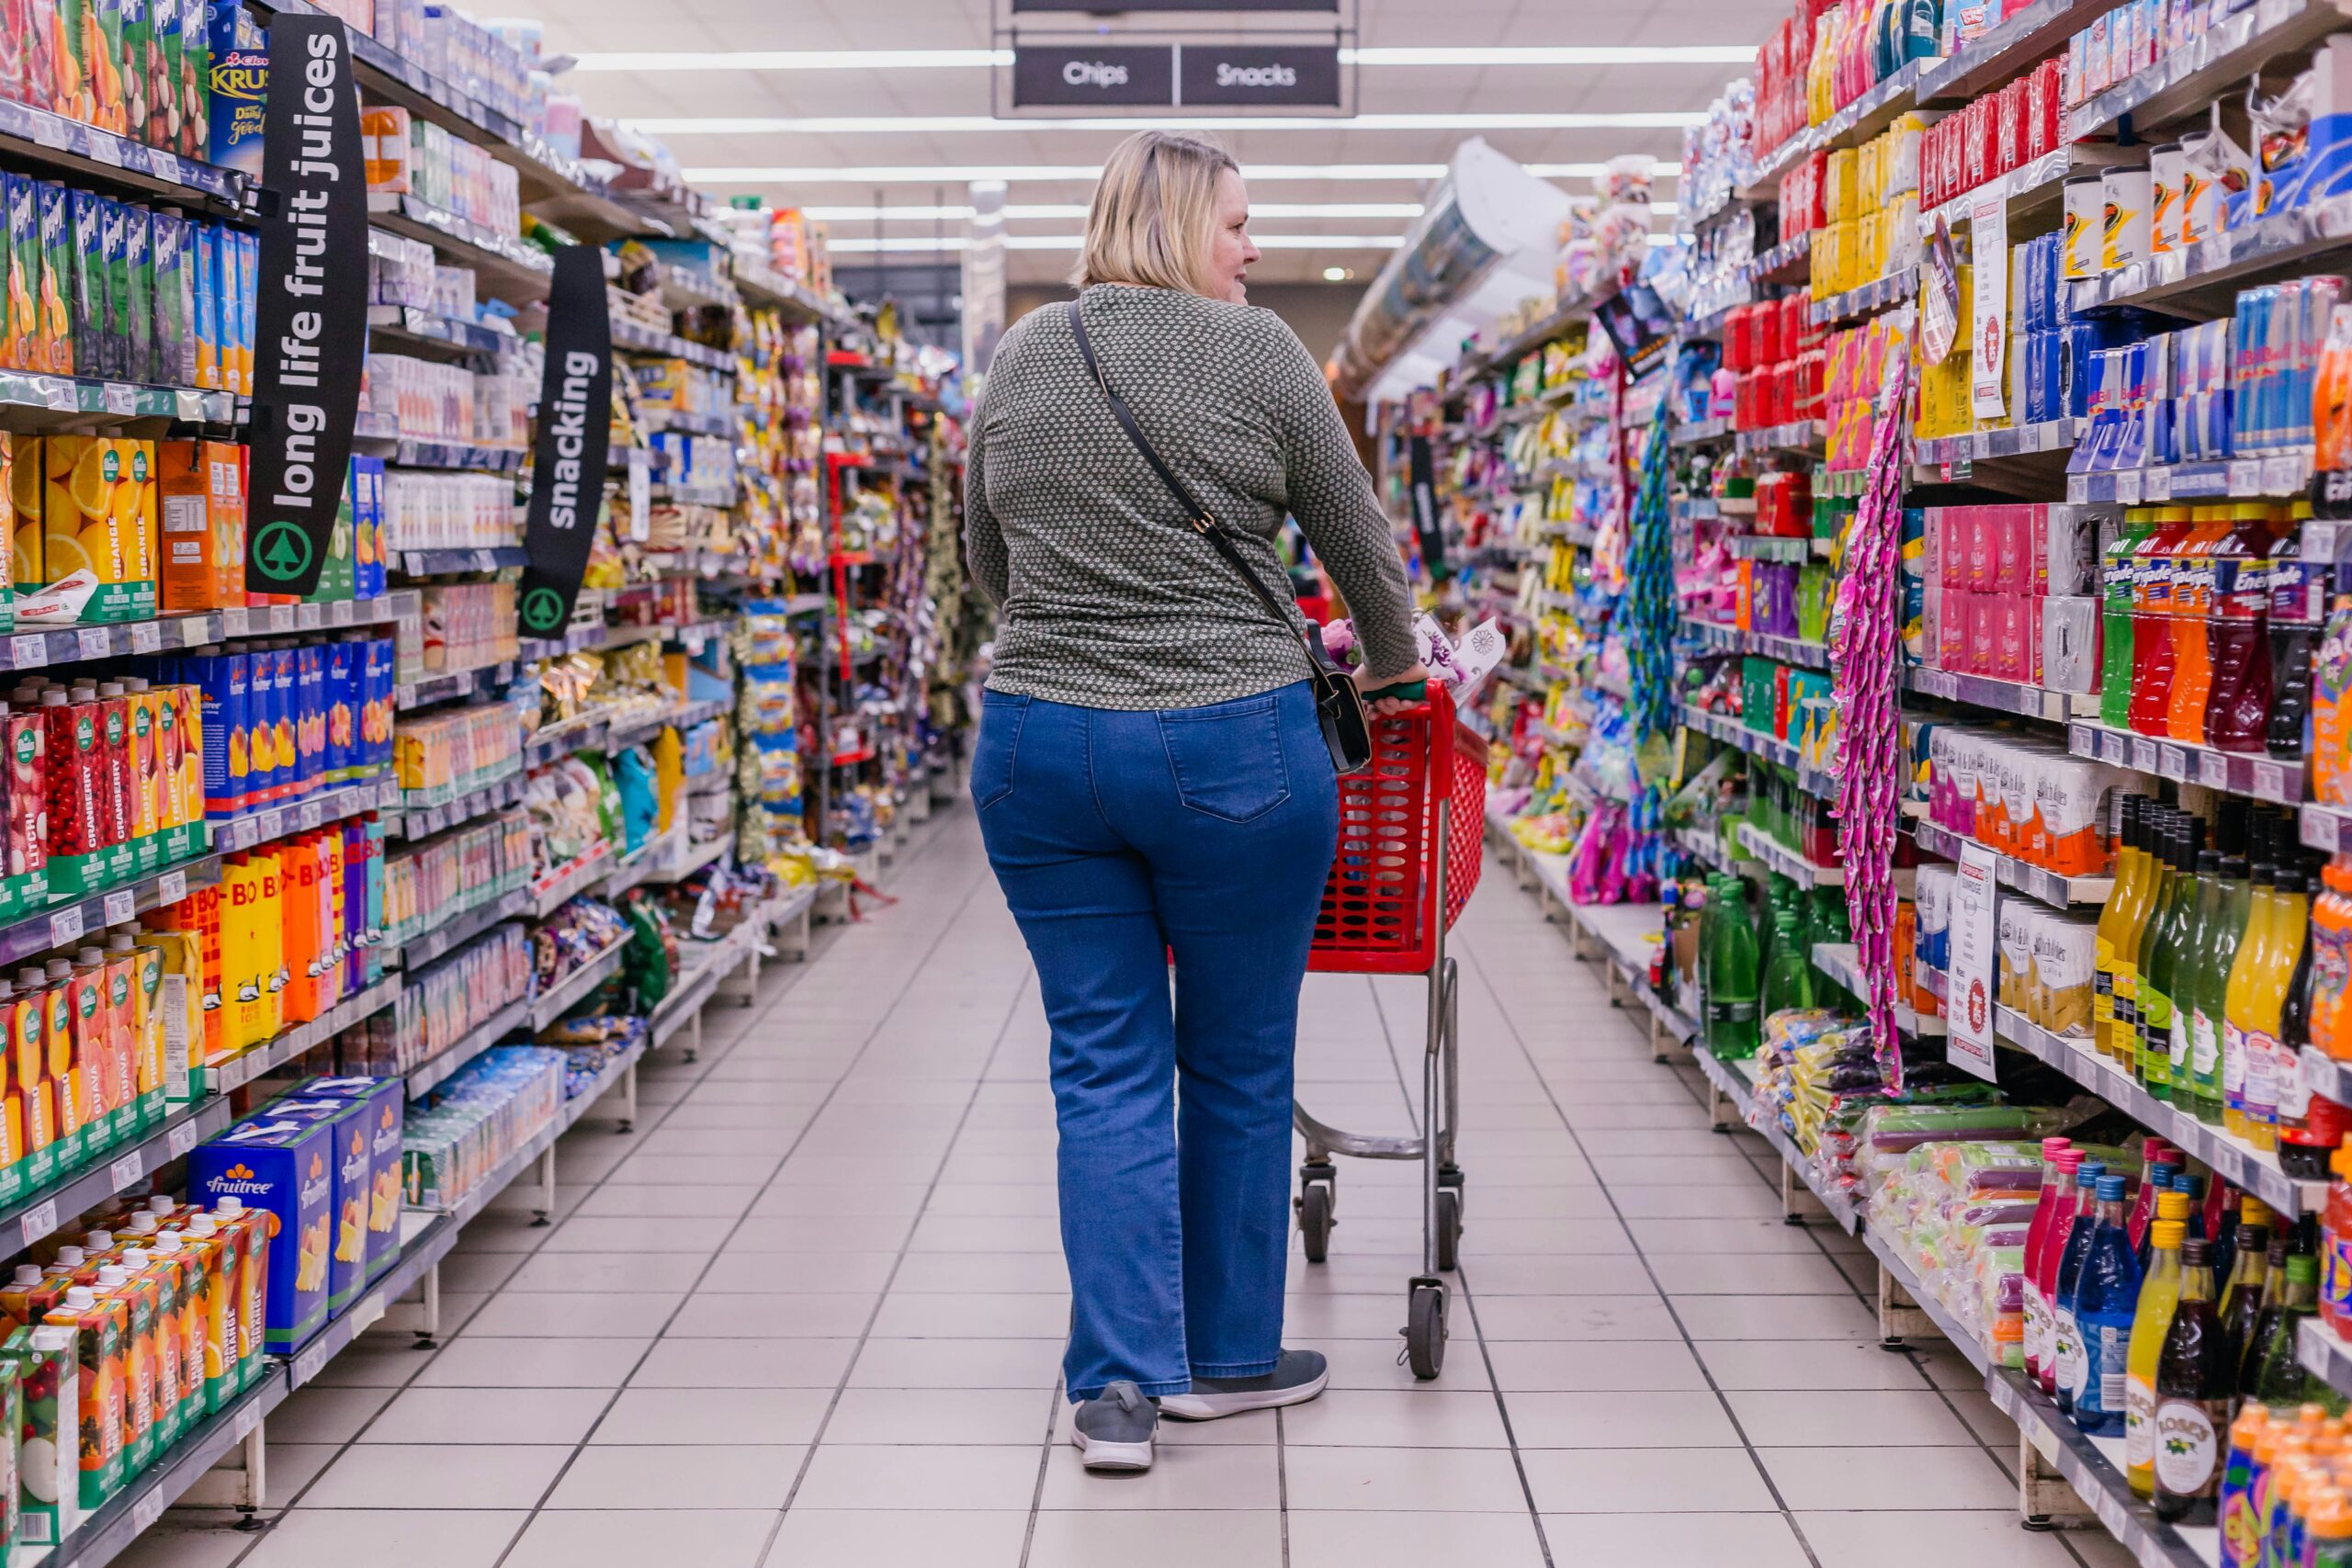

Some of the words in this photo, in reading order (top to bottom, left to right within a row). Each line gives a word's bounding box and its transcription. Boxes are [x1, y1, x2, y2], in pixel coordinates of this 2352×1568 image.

[210, 69, 268, 89] KRU
[242, 55, 269, 66] Clov
[1063, 61, 1128, 88] Chips
[1216, 62, 1296, 86] Snacks
[290, 33, 340, 182] juices
[285, 189, 328, 297] fruit
[279, 310, 322, 387] life
[273, 403, 326, 508] long
[549, 350, 599, 530] snacking
[107, 516, 122, 580] ORANGE
[137, 515, 148, 578] ORANGE
[83, 765, 96, 849] CRANBERRY
[112, 759, 125, 840] CRANBERRY
[141, 755, 152, 831] TROPICAL
[166, 750, 180, 823] TROPICAL
[25, 812, 40, 868] LITCHI
[62, 1072, 75, 1131] MANGO
[90, 1064, 102, 1115] GUAVA
[119, 1051, 130, 1100] GUAVA
[32, 1086, 44, 1146] MANGO
[207, 1175, 273, 1194] fruitree
[228, 1308, 237, 1365] ORANGE
